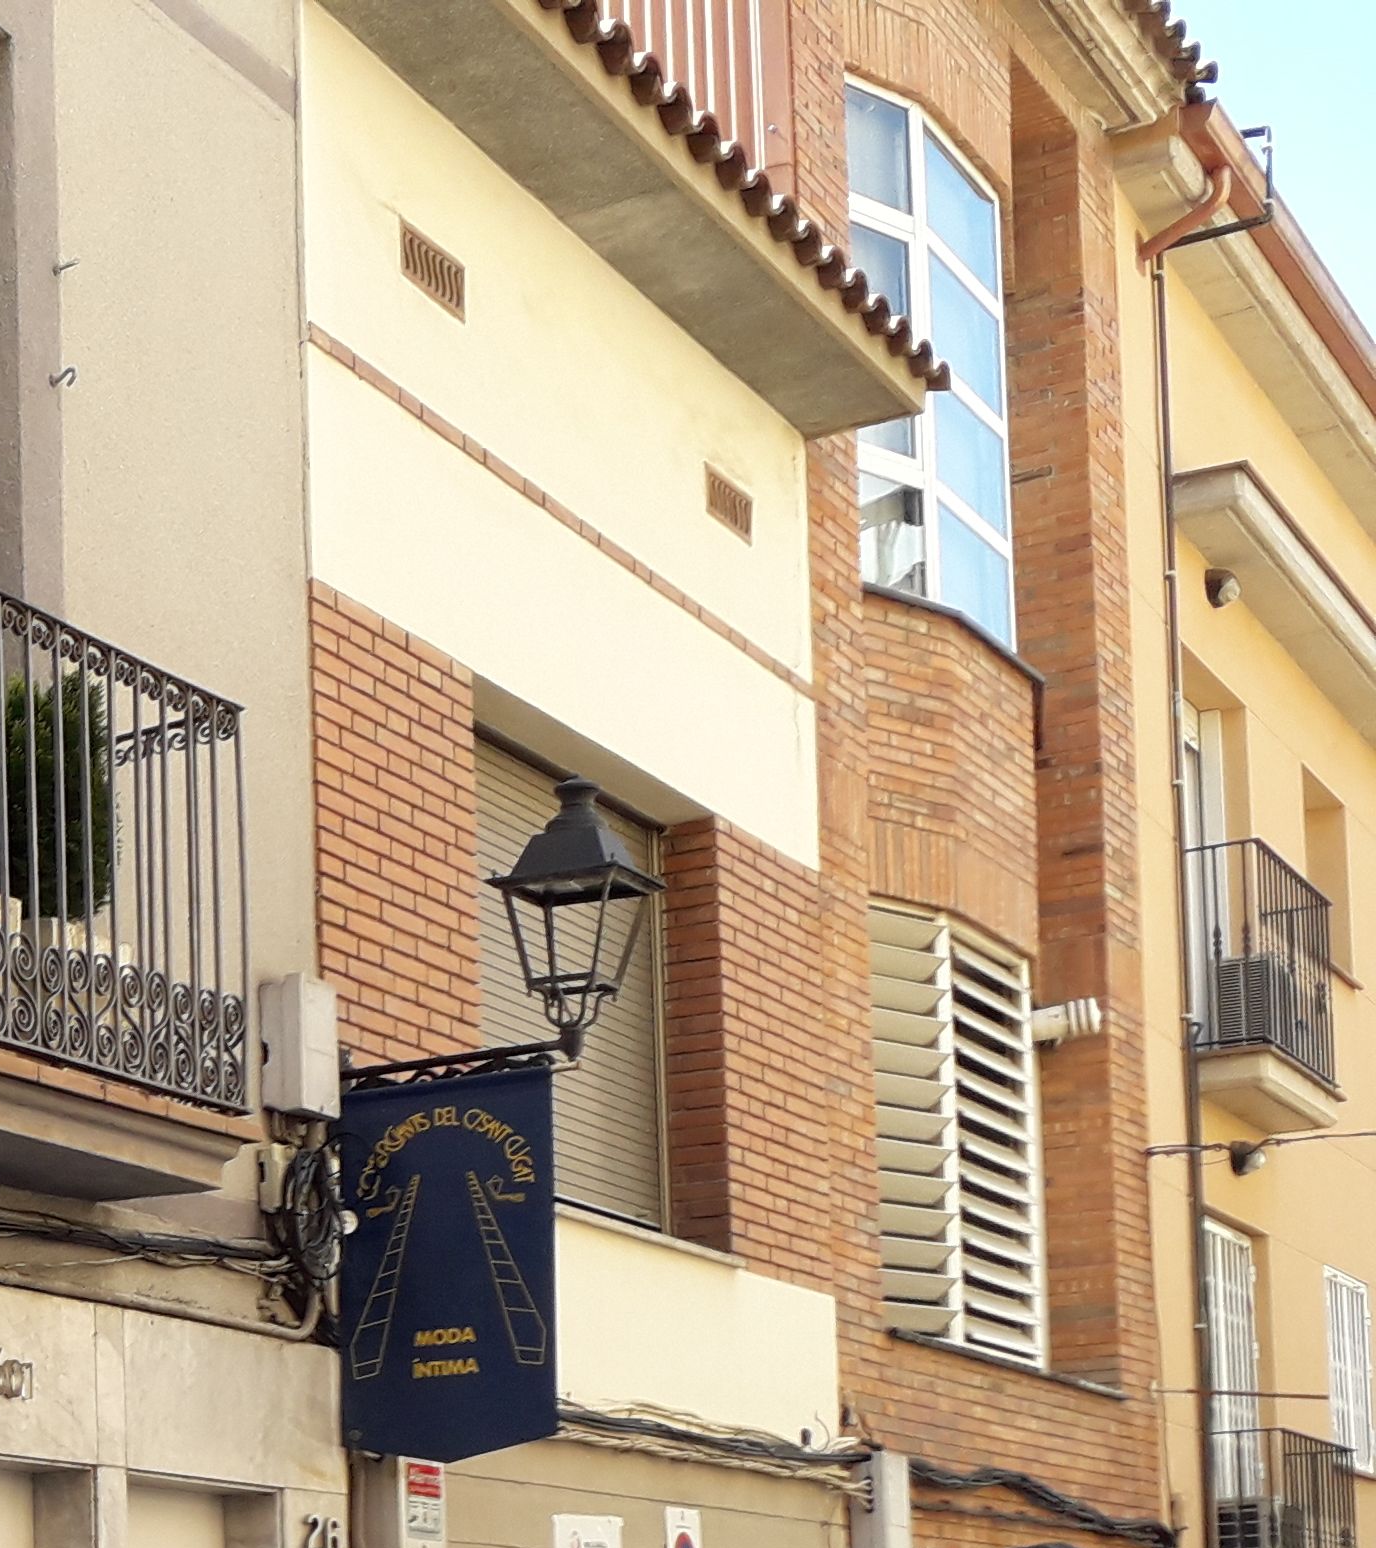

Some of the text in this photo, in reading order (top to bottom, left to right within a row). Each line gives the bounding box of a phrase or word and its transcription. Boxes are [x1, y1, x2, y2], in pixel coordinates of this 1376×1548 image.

[433, 1106, 461, 1126] DEL
[504, 1135, 536, 1184] CUGAT
[413, 1327, 477, 1347] MODA
